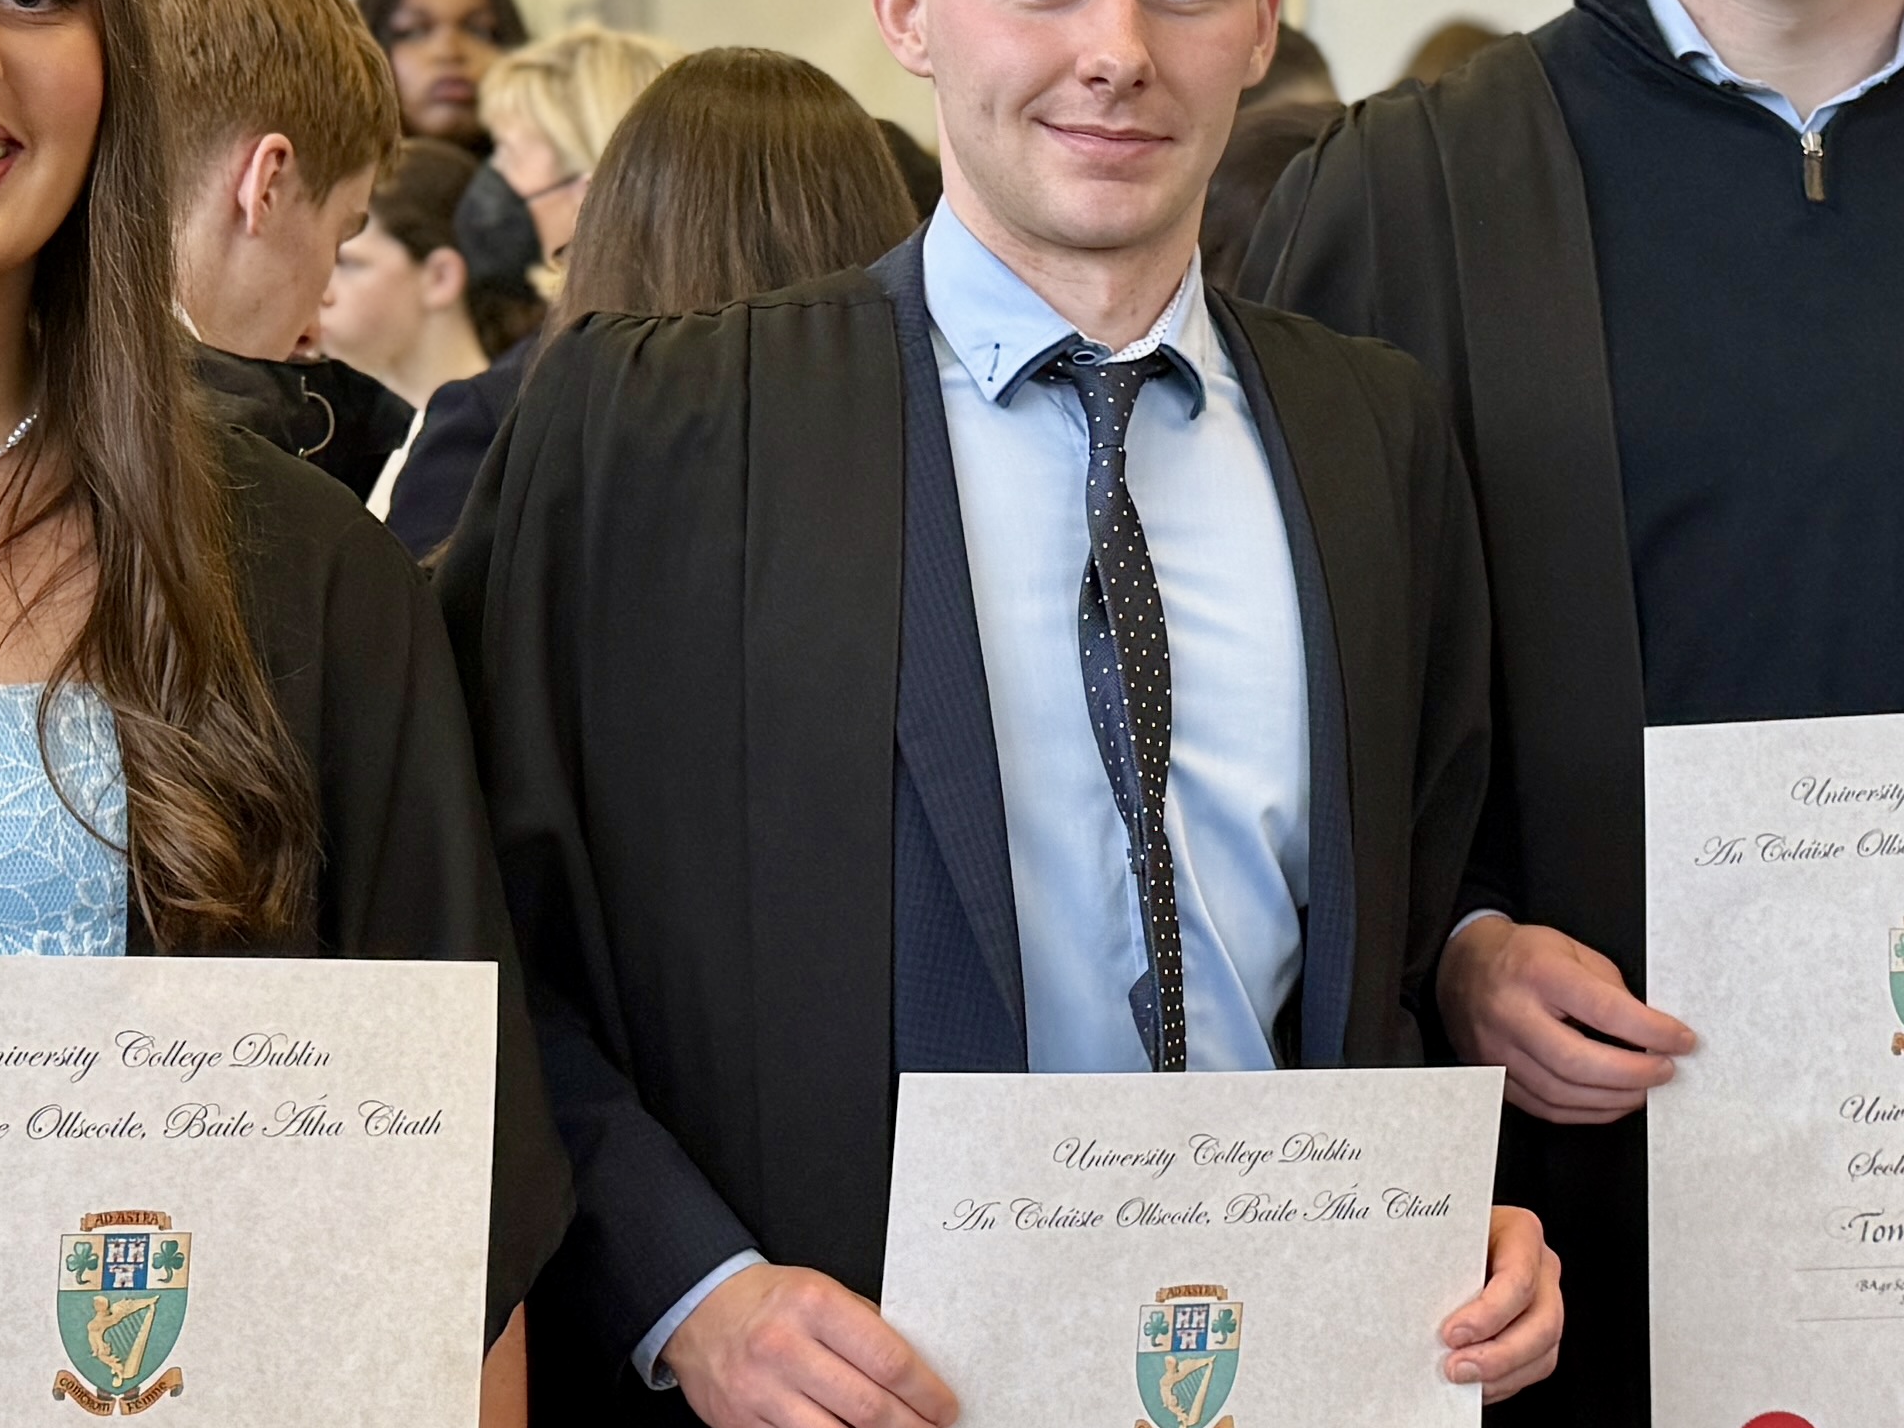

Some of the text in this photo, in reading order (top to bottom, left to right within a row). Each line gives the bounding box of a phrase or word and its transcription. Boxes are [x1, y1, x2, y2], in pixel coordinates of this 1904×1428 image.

[1695, 836, 1746, 866] An
[115, 1030, 222, 1083] College
[230, 1032, 332, 1068] Dublin
[164, 1103, 254, 1139] Baile
[262, 1094, 344, 1139] Átha
[359, 1100, 443, 1136] Cliath
[1053, 1132, 1363, 1179] University College Dublin
[943, 1199, 1000, 1231] An
[1010, 1198, 1104, 1230] Coláiste
[1225, 1193, 1298, 1224] Baile
[1303, 1183, 1370, 1222] Átha
[1382, 1187, 1450, 1218] Cliath
